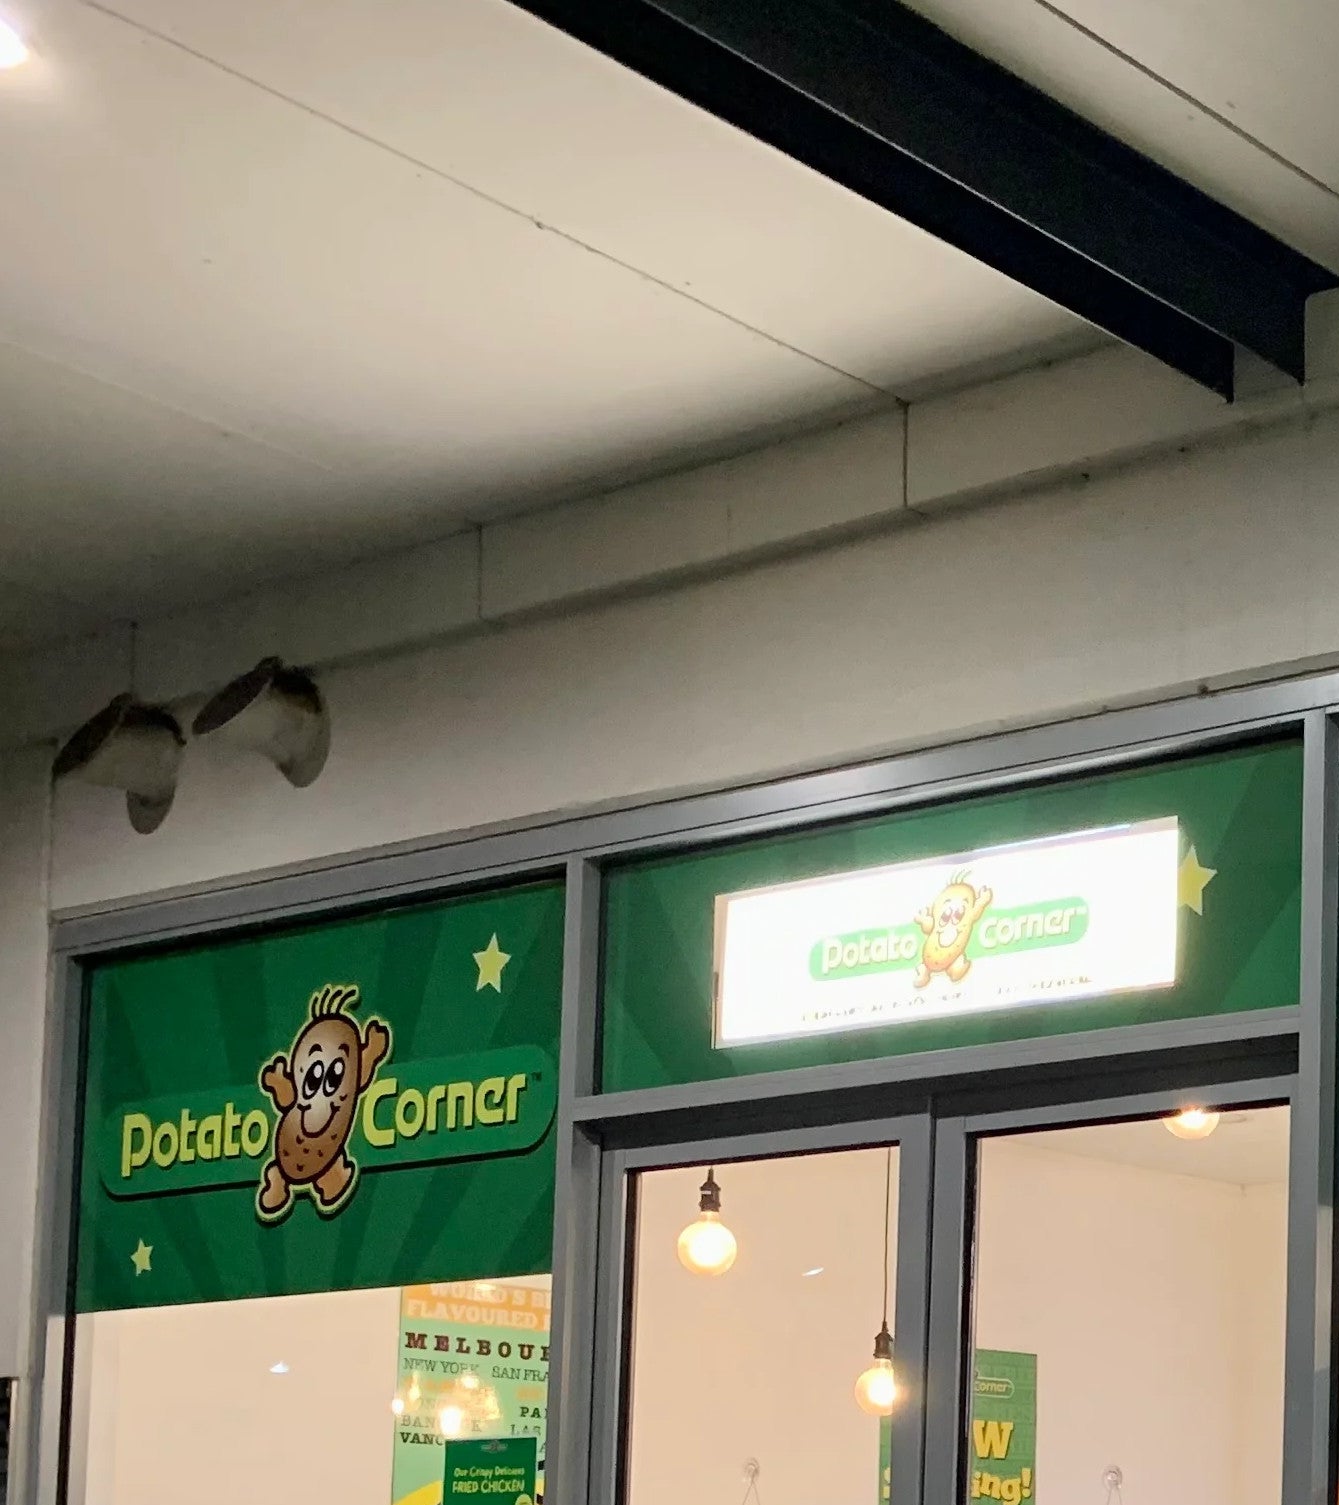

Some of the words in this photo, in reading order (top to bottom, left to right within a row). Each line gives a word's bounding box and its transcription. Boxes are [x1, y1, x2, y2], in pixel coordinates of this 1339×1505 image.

[822, 930, 917, 974] Potato
[121, 1107, 268, 1177] Potato
[363, 1073, 526, 1146] Corner
[404, 1358, 436, 1372] NEW
[492, 1366, 520, 1380] SAN
[452, 1481, 479, 1493] FRIED
[481, 1480, 526, 1493] CHICKEN
